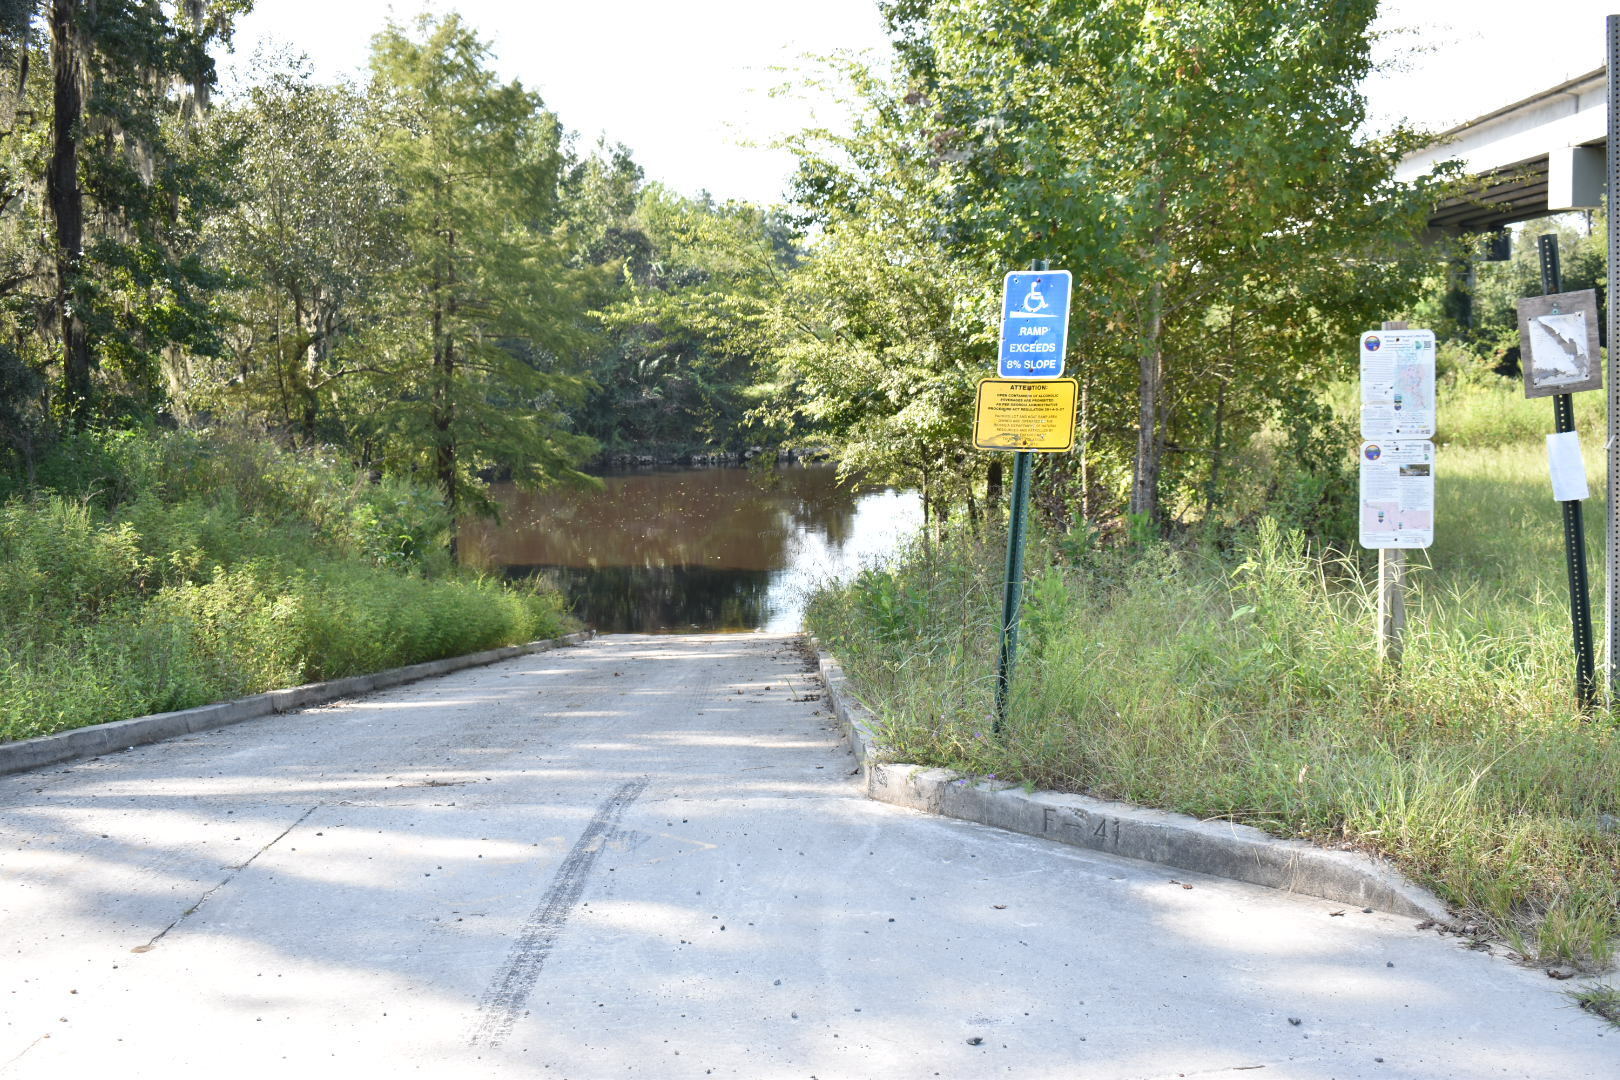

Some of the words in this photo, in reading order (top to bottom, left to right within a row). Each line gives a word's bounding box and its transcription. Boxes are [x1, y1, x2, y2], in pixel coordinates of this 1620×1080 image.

[1019, 326, 1049, 336] RAMP
[1009, 343, 1057, 353] EXCEEDS
[1006, 360, 1022, 369] 8%
[1024, 360, 1057, 369] SLOPE
